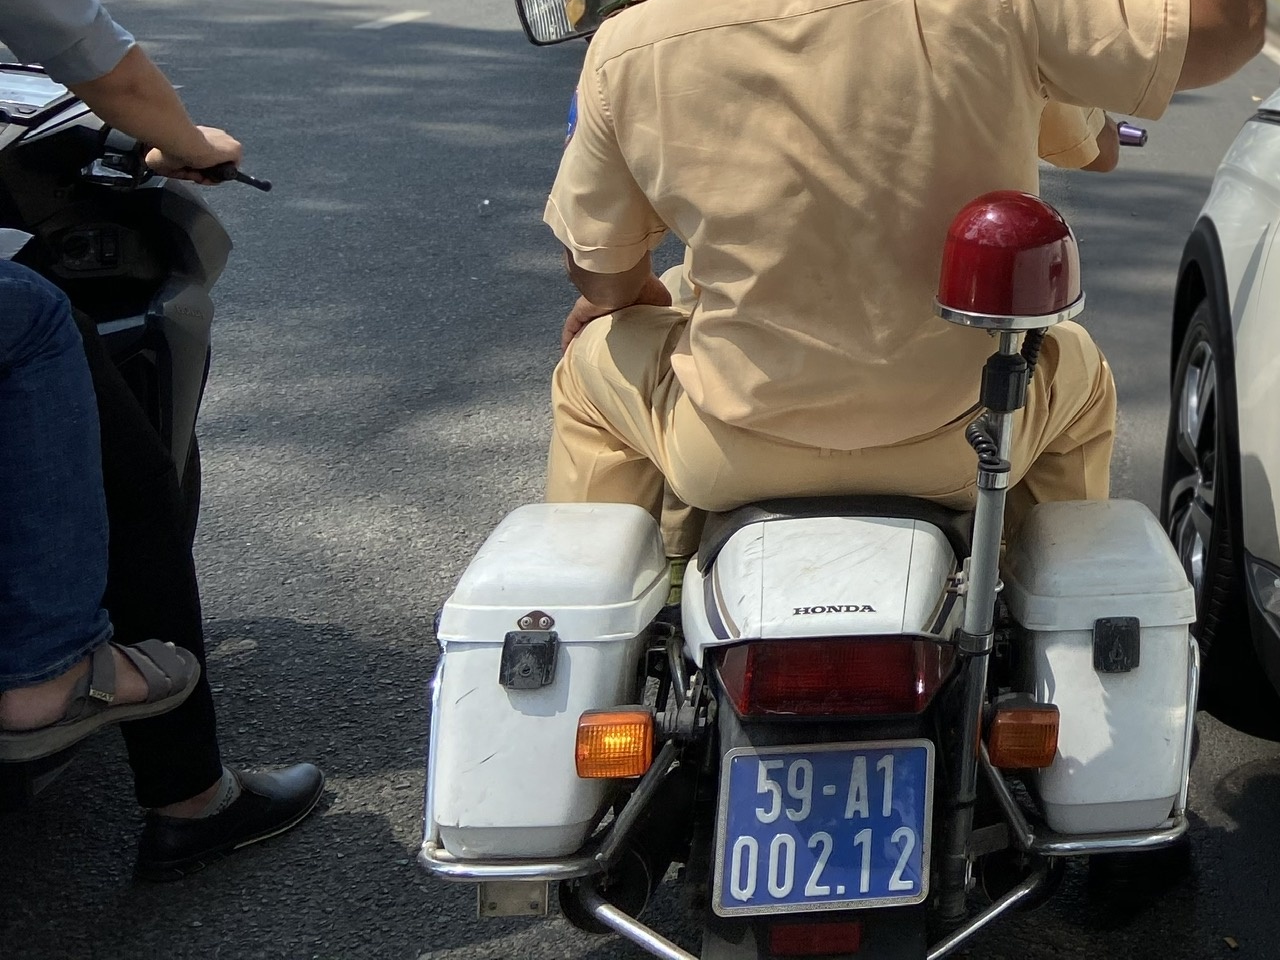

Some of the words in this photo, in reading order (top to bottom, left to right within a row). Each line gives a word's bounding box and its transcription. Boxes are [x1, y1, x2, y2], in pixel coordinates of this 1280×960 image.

[792, 605, 876, 616] HONDA
[756, 754, 894, 823] 59-A1
[730, 826, 916, 901] 002.12
